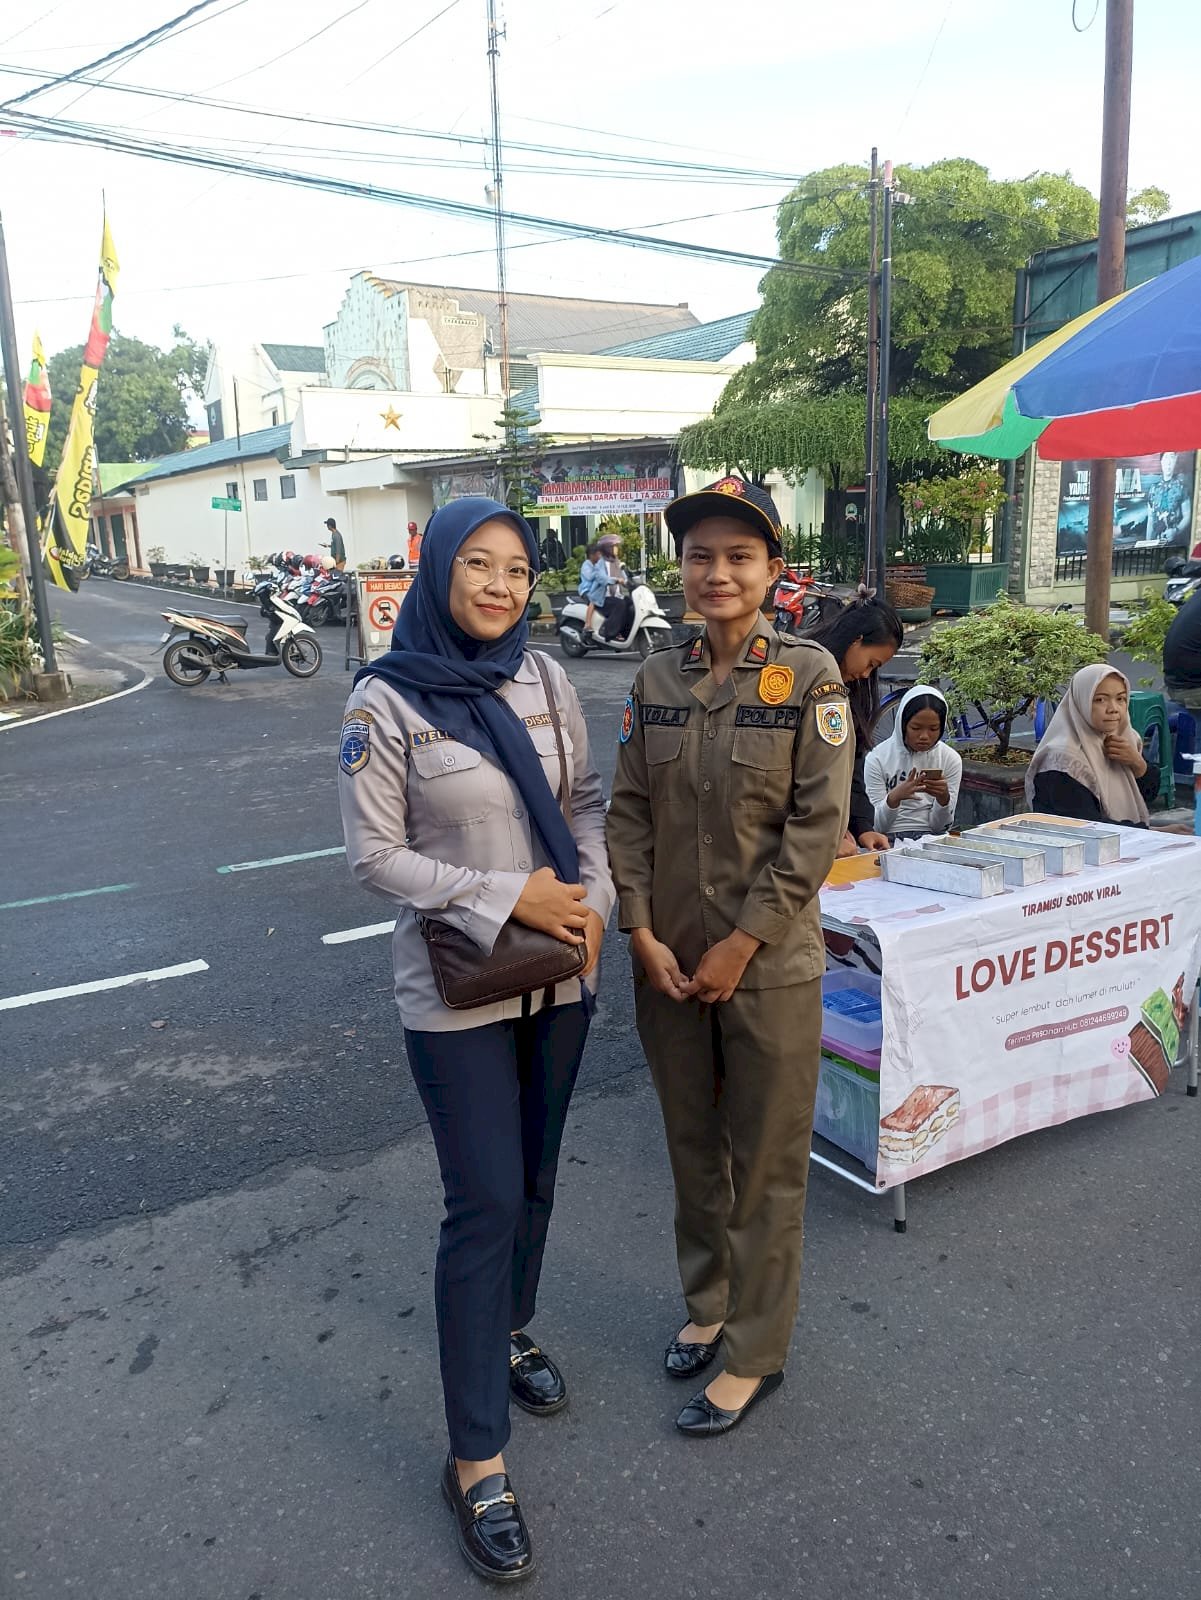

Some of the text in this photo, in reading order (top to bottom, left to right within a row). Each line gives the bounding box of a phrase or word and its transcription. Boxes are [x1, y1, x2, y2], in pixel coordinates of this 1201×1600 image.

[554, 493, 592, 502] ANGKATAN
[595, 492, 617, 501] DARAT
[620, 491, 633, 500] GEL
[370, 583, 383, 591] HARI
[385, 582, 402, 590] BEBAS
[741, 709, 797, 725] POL PP
[1022, 884, 1122, 918] TIRAMISU SODOK VIRAL
[955, 913, 1174, 1000] LOVE DESSERT
[1021, 1001, 1050, 1016] lembut
[1055, 997, 1074, 1008] dan
[1075, 990, 1097, 1004] lumer
[1099, 987, 1107, 996] di
[1008, 1034, 1030, 1046] Terima
